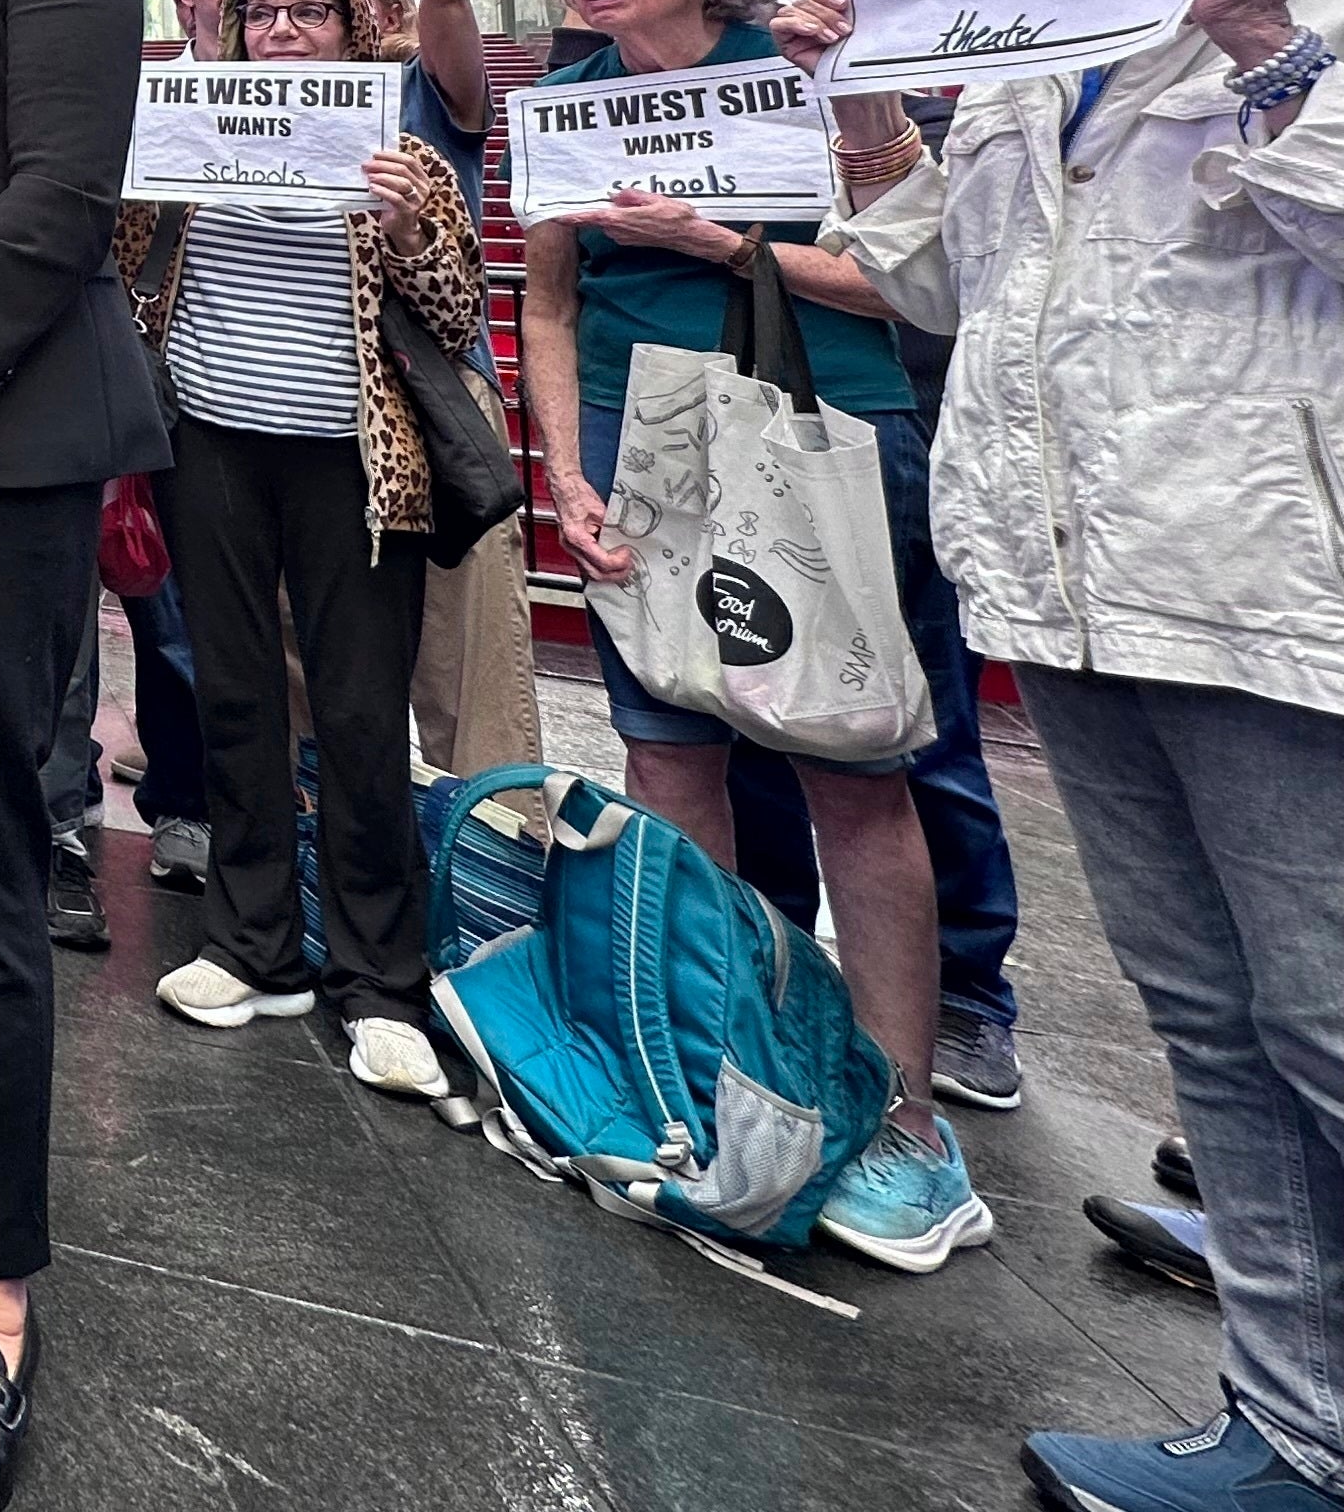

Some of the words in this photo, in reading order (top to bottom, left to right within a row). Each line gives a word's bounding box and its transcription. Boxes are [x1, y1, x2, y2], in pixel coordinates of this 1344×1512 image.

[930, 10, 1057, 54] theater
[146, 77, 199, 104] THE
[205, 77, 293, 107] WEST
[300, 79, 374, 109] SIDE
[533, 100, 598, 133] THE
[603, 87, 707, 128] WEST
[717, 75, 807, 116] SIDE
[217, 116, 292, 137] WANTS
[623, 130, 714, 157] WANTS
